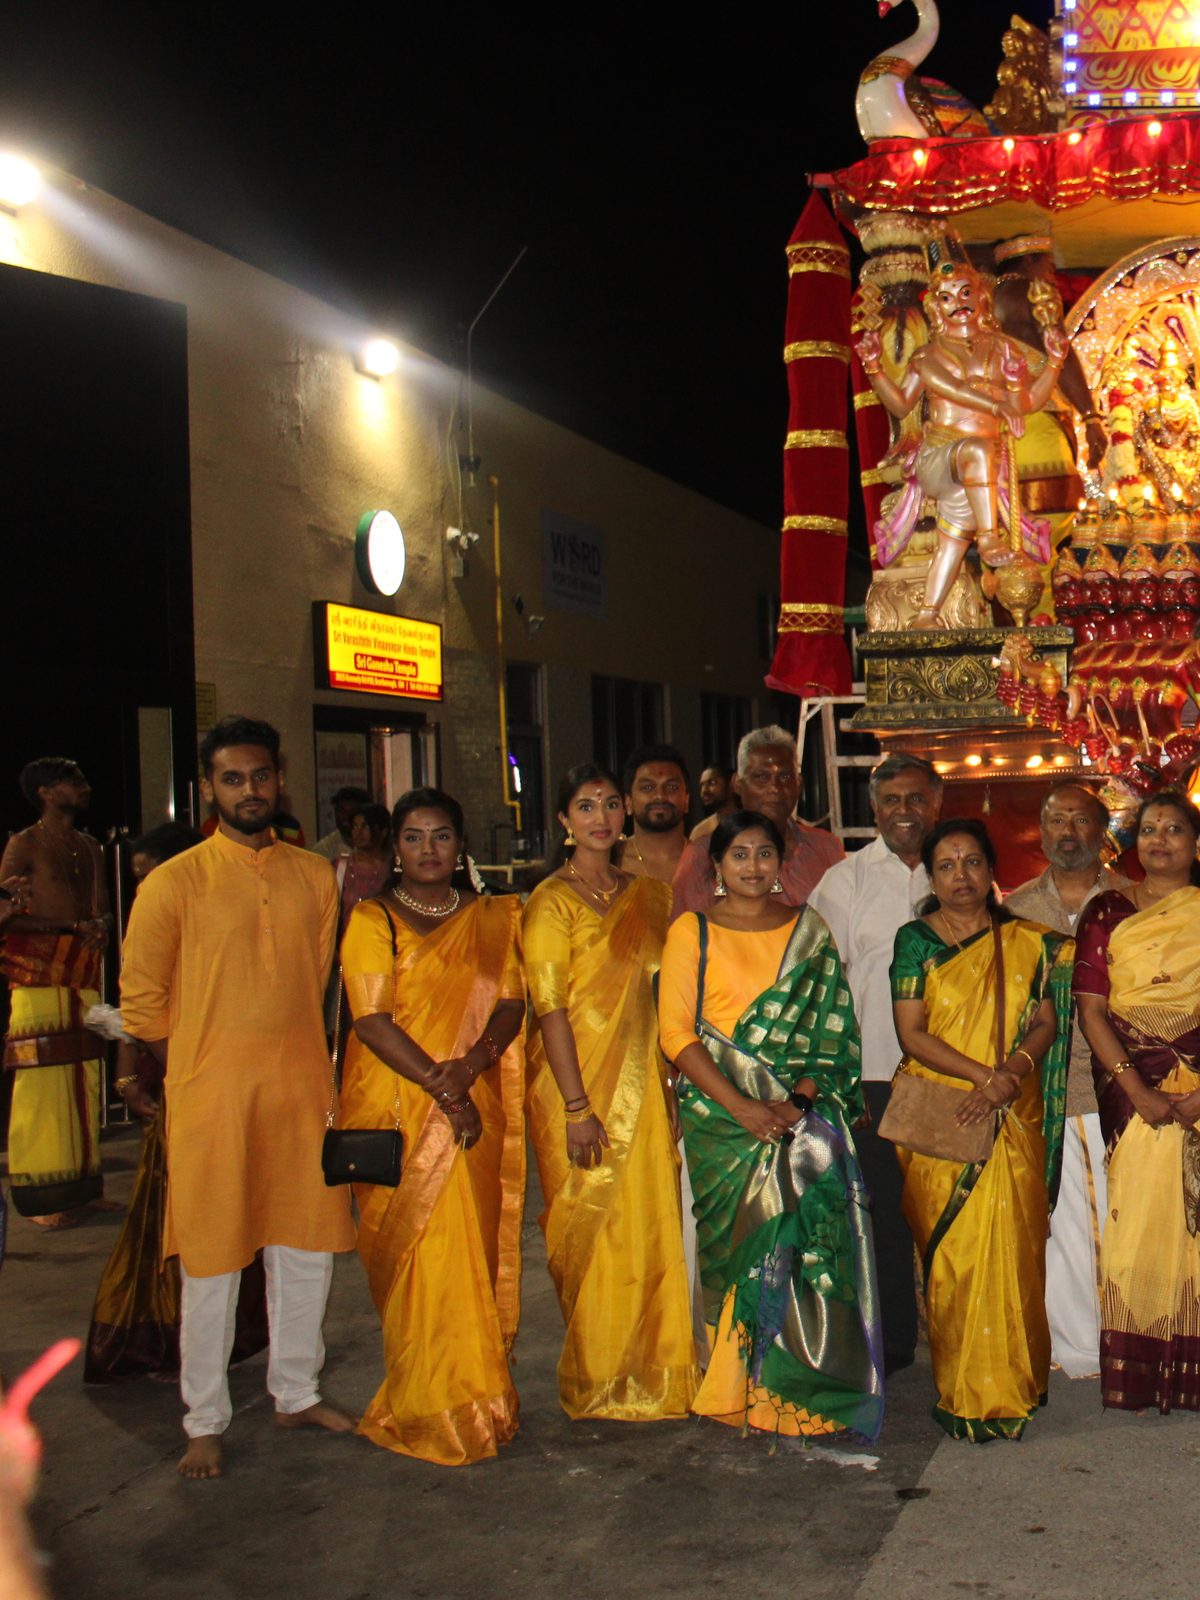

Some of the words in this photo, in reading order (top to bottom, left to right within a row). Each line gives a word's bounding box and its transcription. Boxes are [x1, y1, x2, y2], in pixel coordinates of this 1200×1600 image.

[357, 656, 366, 669] Sri
[367, 657, 393, 672] Ganesha
[395, 662, 416, 677] Temple
